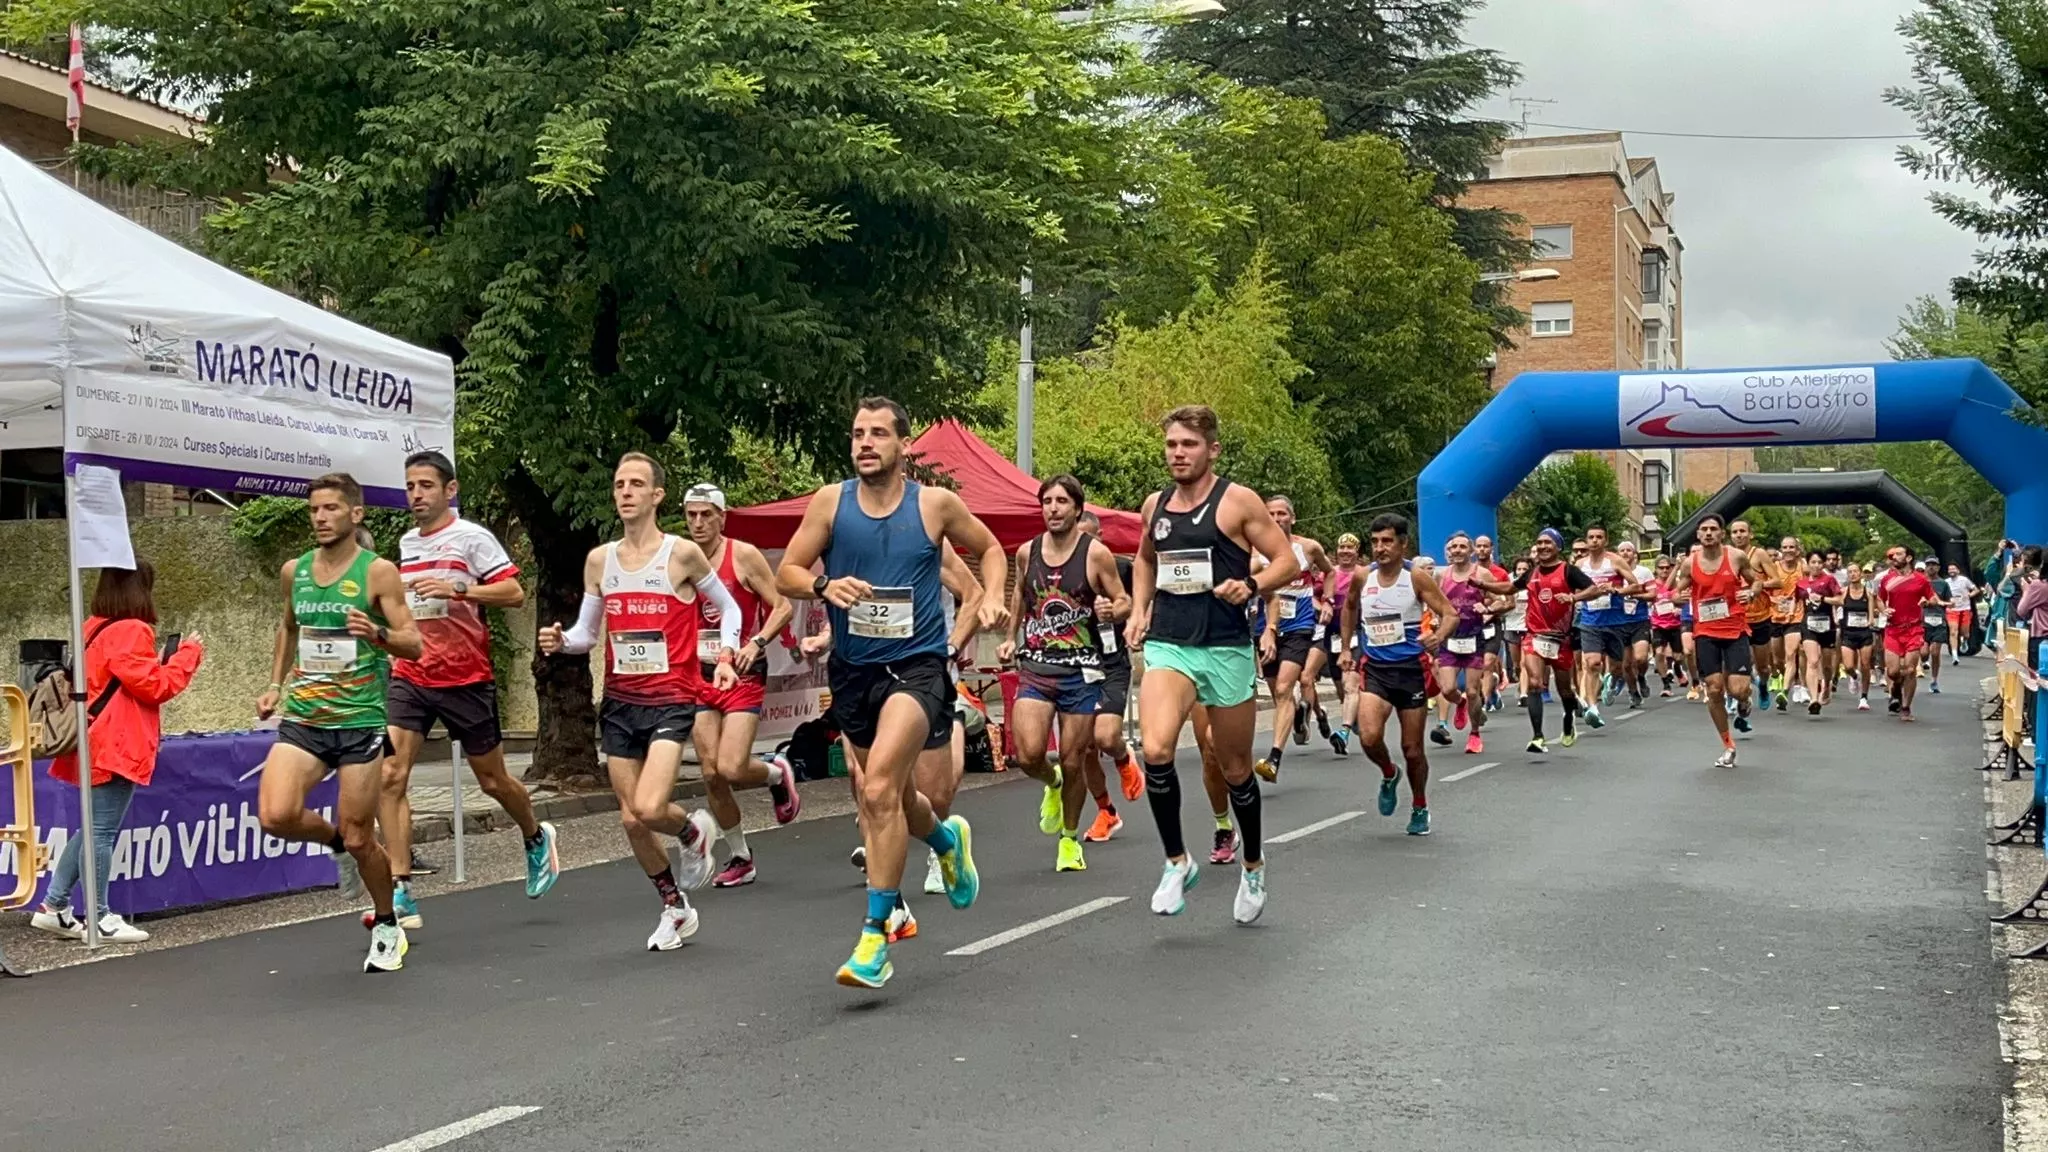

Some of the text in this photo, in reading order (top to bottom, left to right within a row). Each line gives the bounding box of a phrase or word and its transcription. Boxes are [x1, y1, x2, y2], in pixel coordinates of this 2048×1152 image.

[195, 340, 320, 393] MARATÓ
[329, 360, 414, 415] LLEIDA
[1744, 373, 1868, 388] Club Atletismo
[76, 385, 121, 403] DIUMENGE
[159, 399, 179, 411] 2024
[1745, 391, 1868, 410] Barbastro
[76, 426, 121, 442] DISSABTE
[127, 432, 137, 444] 26
[159, 437, 178, 449] 2024
[183, 436, 217, 454] Curses
[264, 447, 295, 464] Curses
[297, 451, 332, 468] Infantils
[1174, 565, 1190, 577] 66
[869, 604, 889, 617] 32
[1372, 623, 1396, 633] 1014
[316, 643, 334, 654] 12
[629, 645, 646, 656] 30
